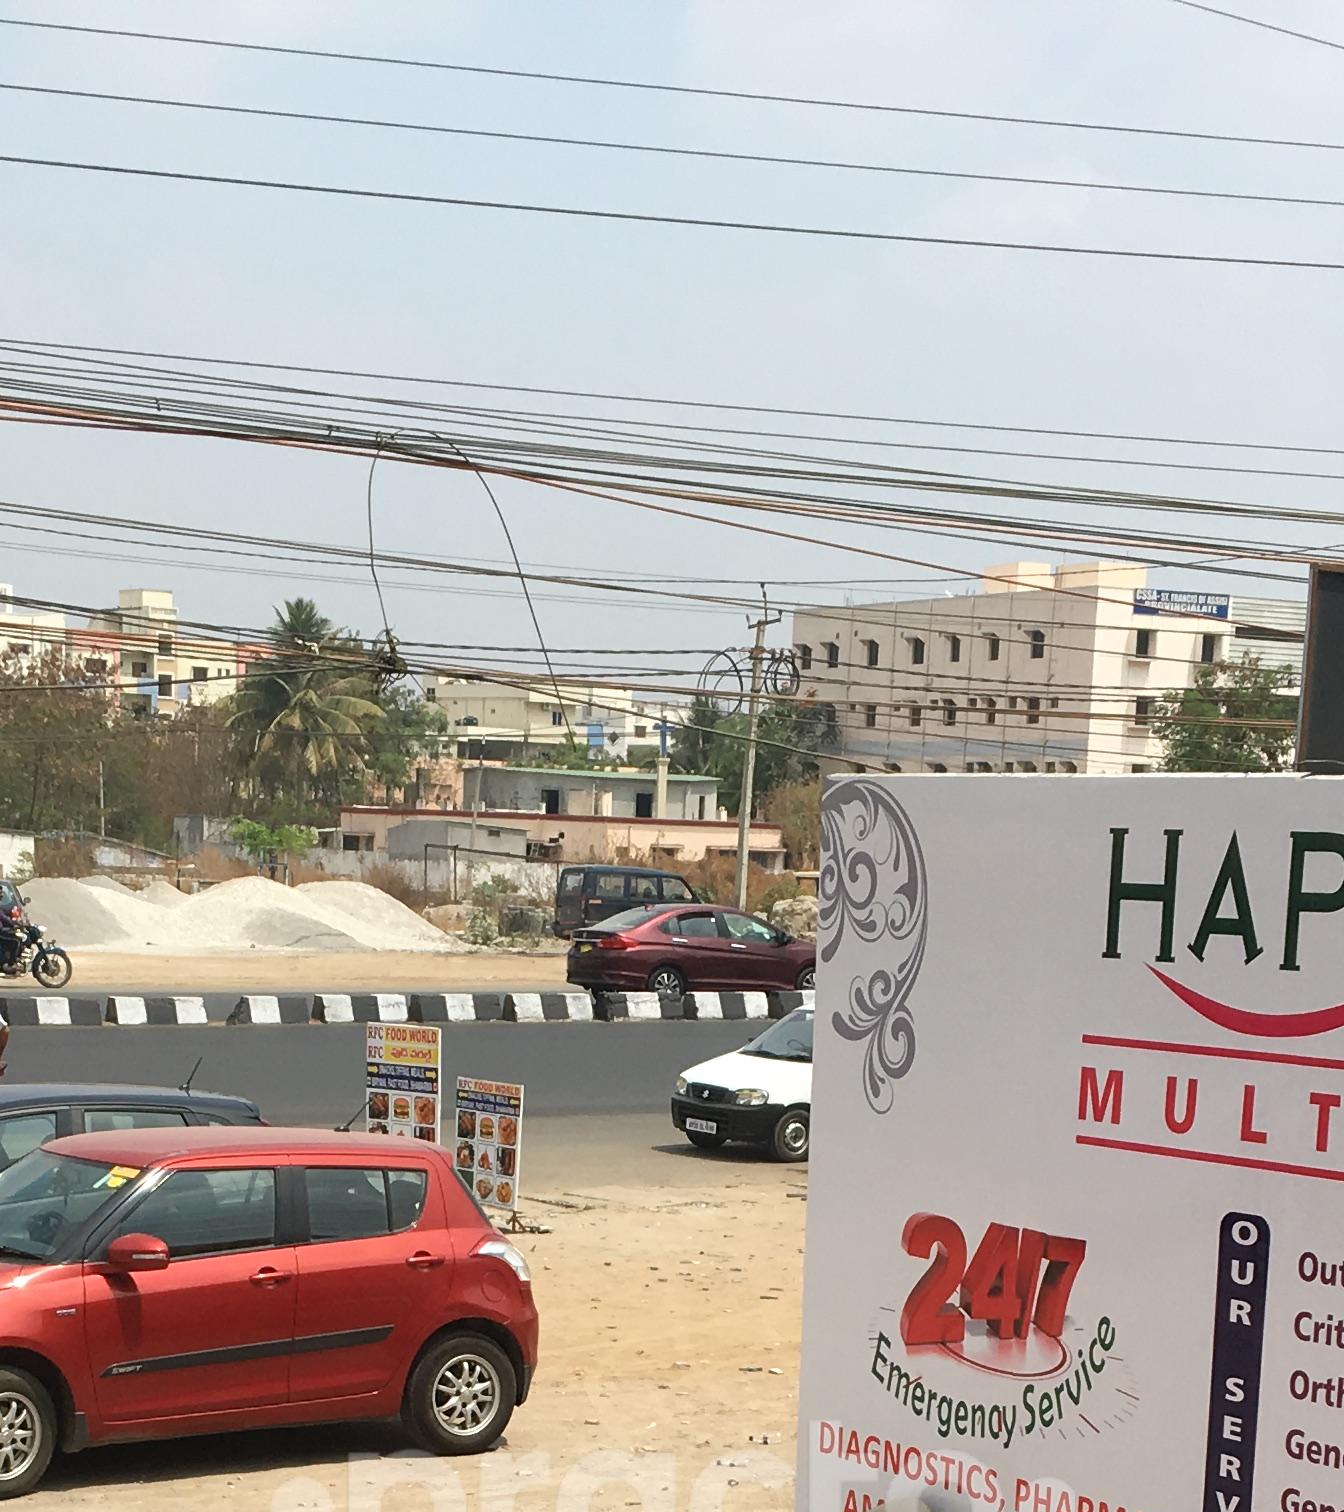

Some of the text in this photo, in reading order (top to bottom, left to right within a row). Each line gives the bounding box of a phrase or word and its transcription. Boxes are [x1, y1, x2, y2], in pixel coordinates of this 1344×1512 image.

[1171, 593, 1197, 603] FRANCIS
[368, 1027, 437, 1043] RFC FOOD WORLD
[368, 1046, 383, 1058] RFC
[475, 1082, 494, 1092] FOOD
[495, 1084, 520, 1096] WORLD
[1229, 1220, 1258, 1326] OUR
[1023, 1315, 1116, 1434] Service
[819, 1421, 1005, 1512] DIAGNOSTICS,
